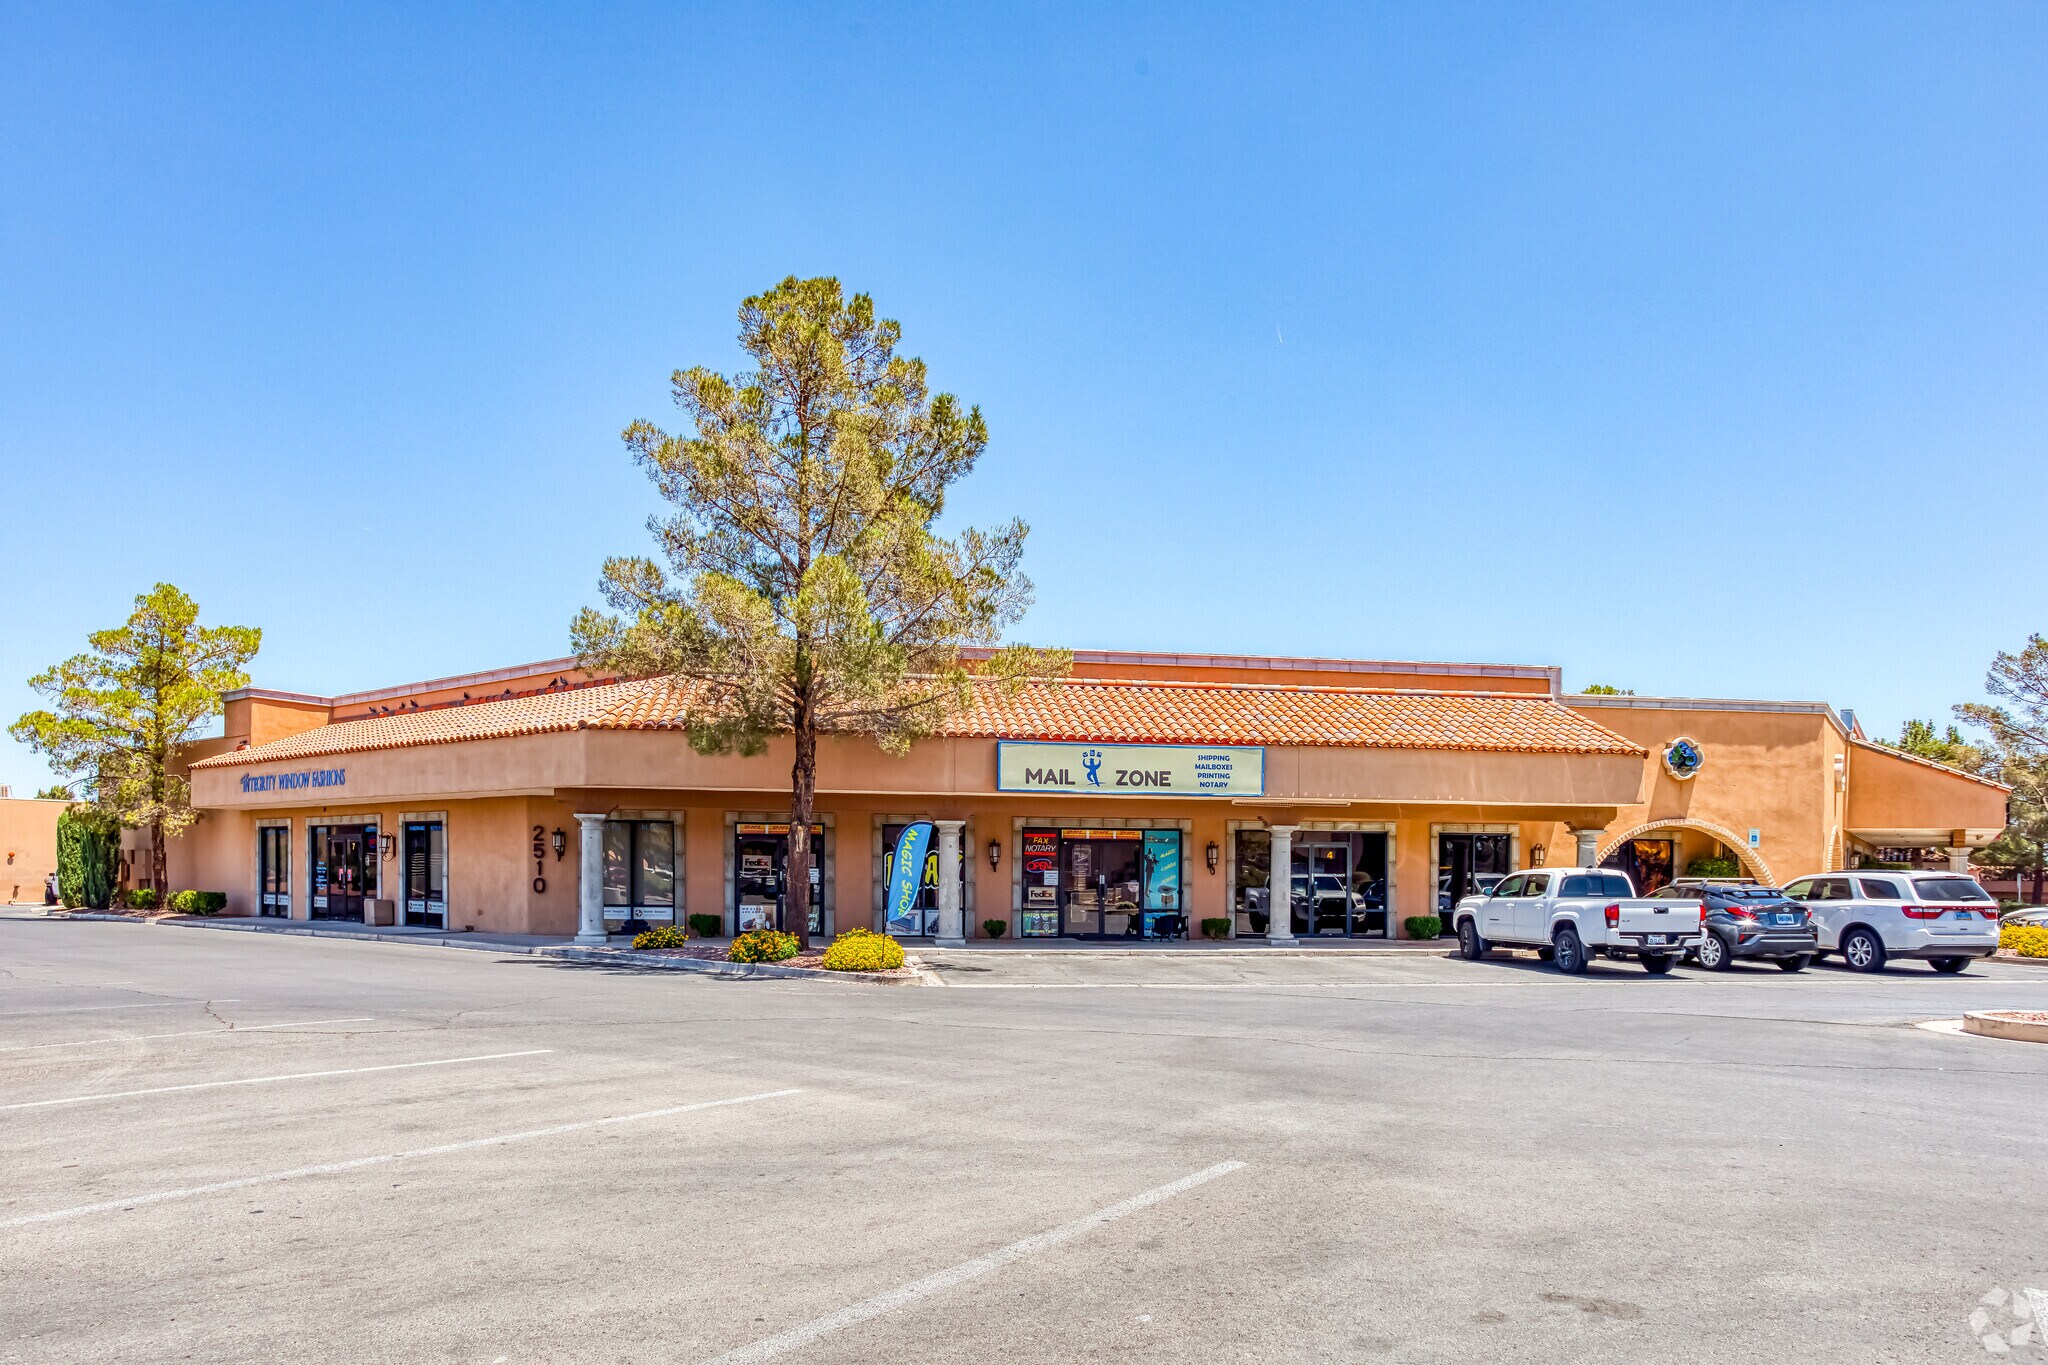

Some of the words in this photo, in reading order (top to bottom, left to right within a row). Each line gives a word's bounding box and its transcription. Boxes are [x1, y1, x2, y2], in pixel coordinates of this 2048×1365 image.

[1197, 754, 1231, 762] SHIPPING
[1194, 763, 1233, 771] MAILBOXES
[278, 771, 311, 790] WINDOW
[312, 768, 346, 788] FASHIONS
[1025, 768, 1076, 785] MAIL
[1115, 769, 1172, 787] ZONE
[1197, 772, 1231, 780] PRINTING
[1199, 781, 1229, 789] NOTARY
[901, 828, 918, 877] MAGIC
[1326, 851, 1333, 860] 4
[533, 825, 546, 894] 2510
[745, 858, 769, 867] FedEx
[1026, 861, 1053, 871] OPEN
[897, 880, 913, 916] SHOP
[1030, 890, 1053, 898] FedEx
